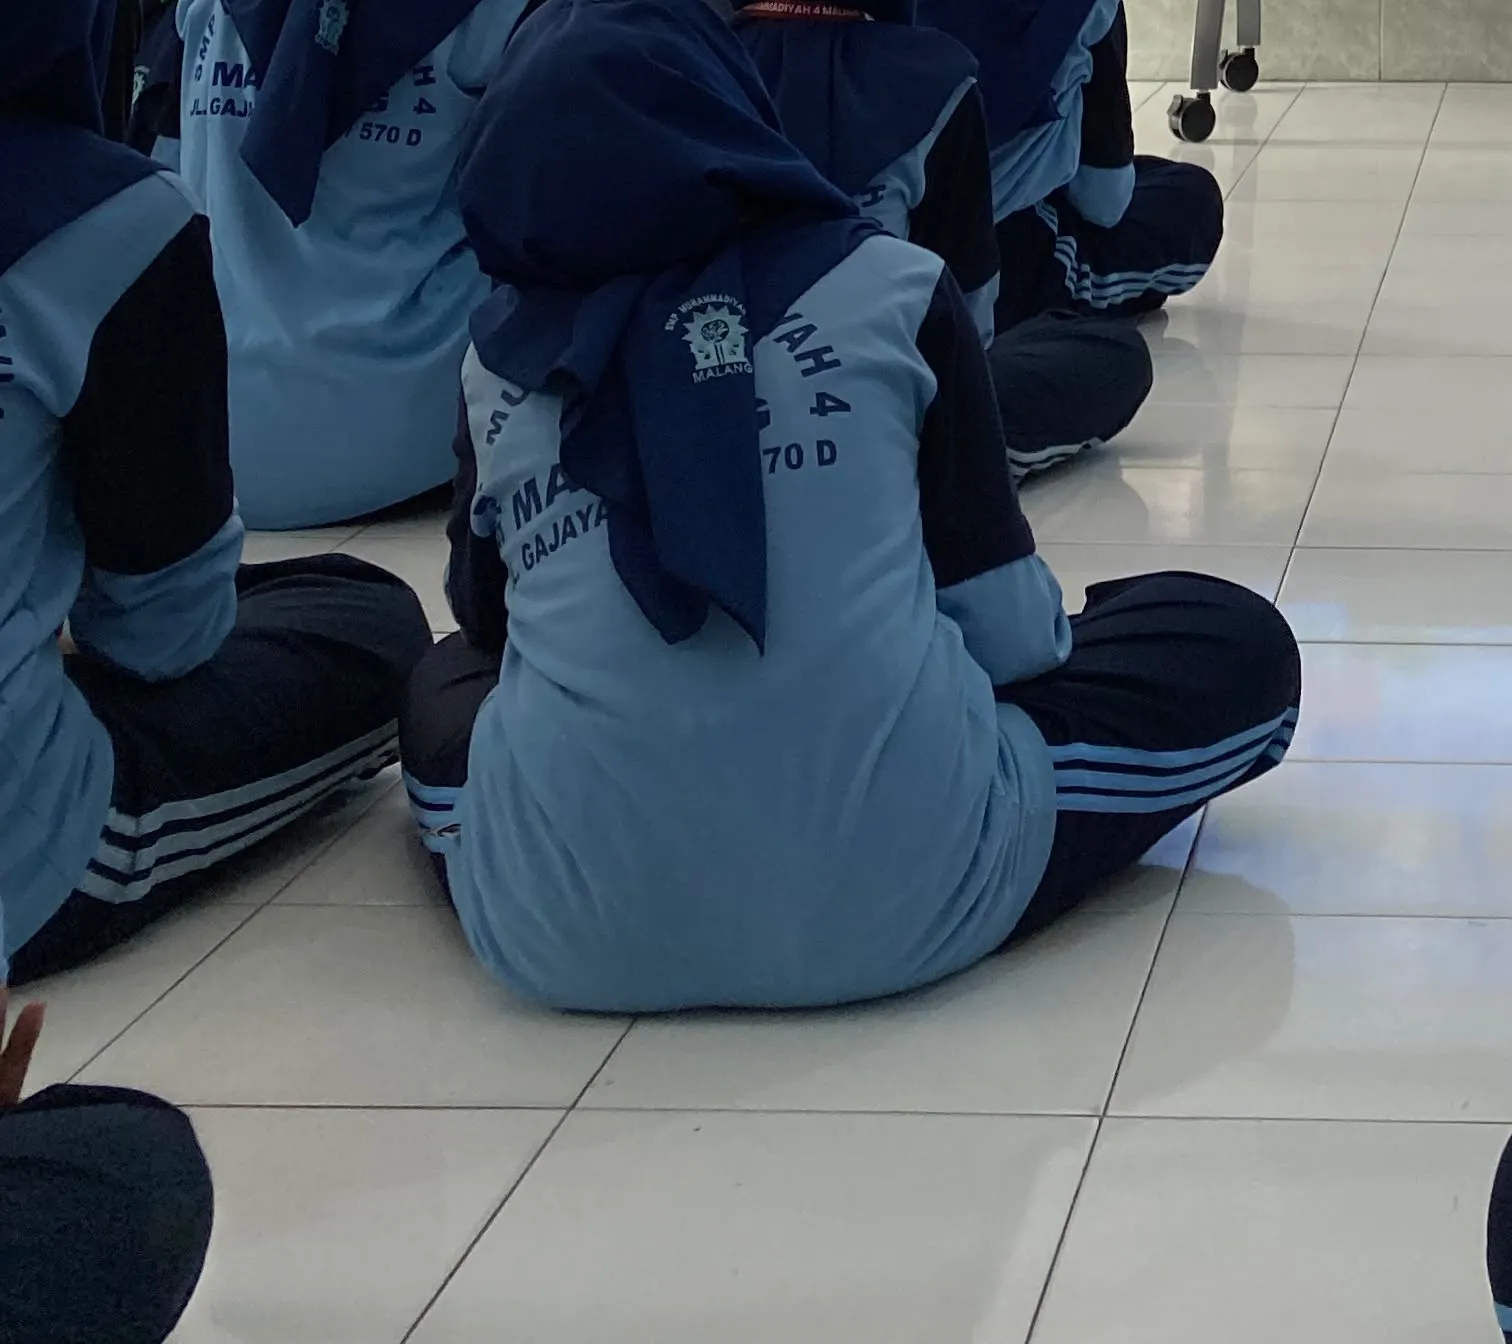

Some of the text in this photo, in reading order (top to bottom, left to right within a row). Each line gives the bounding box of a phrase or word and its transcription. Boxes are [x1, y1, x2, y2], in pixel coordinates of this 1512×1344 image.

[412, 96, 437, 115] 4
[359, 122, 422, 147] 570 D
[692, 363, 753, 384] MALANG
[809, 391, 852, 417] 4
[763, 438, 838, 474] 70 D
[520, 503, 609, 572] GAJAYA
